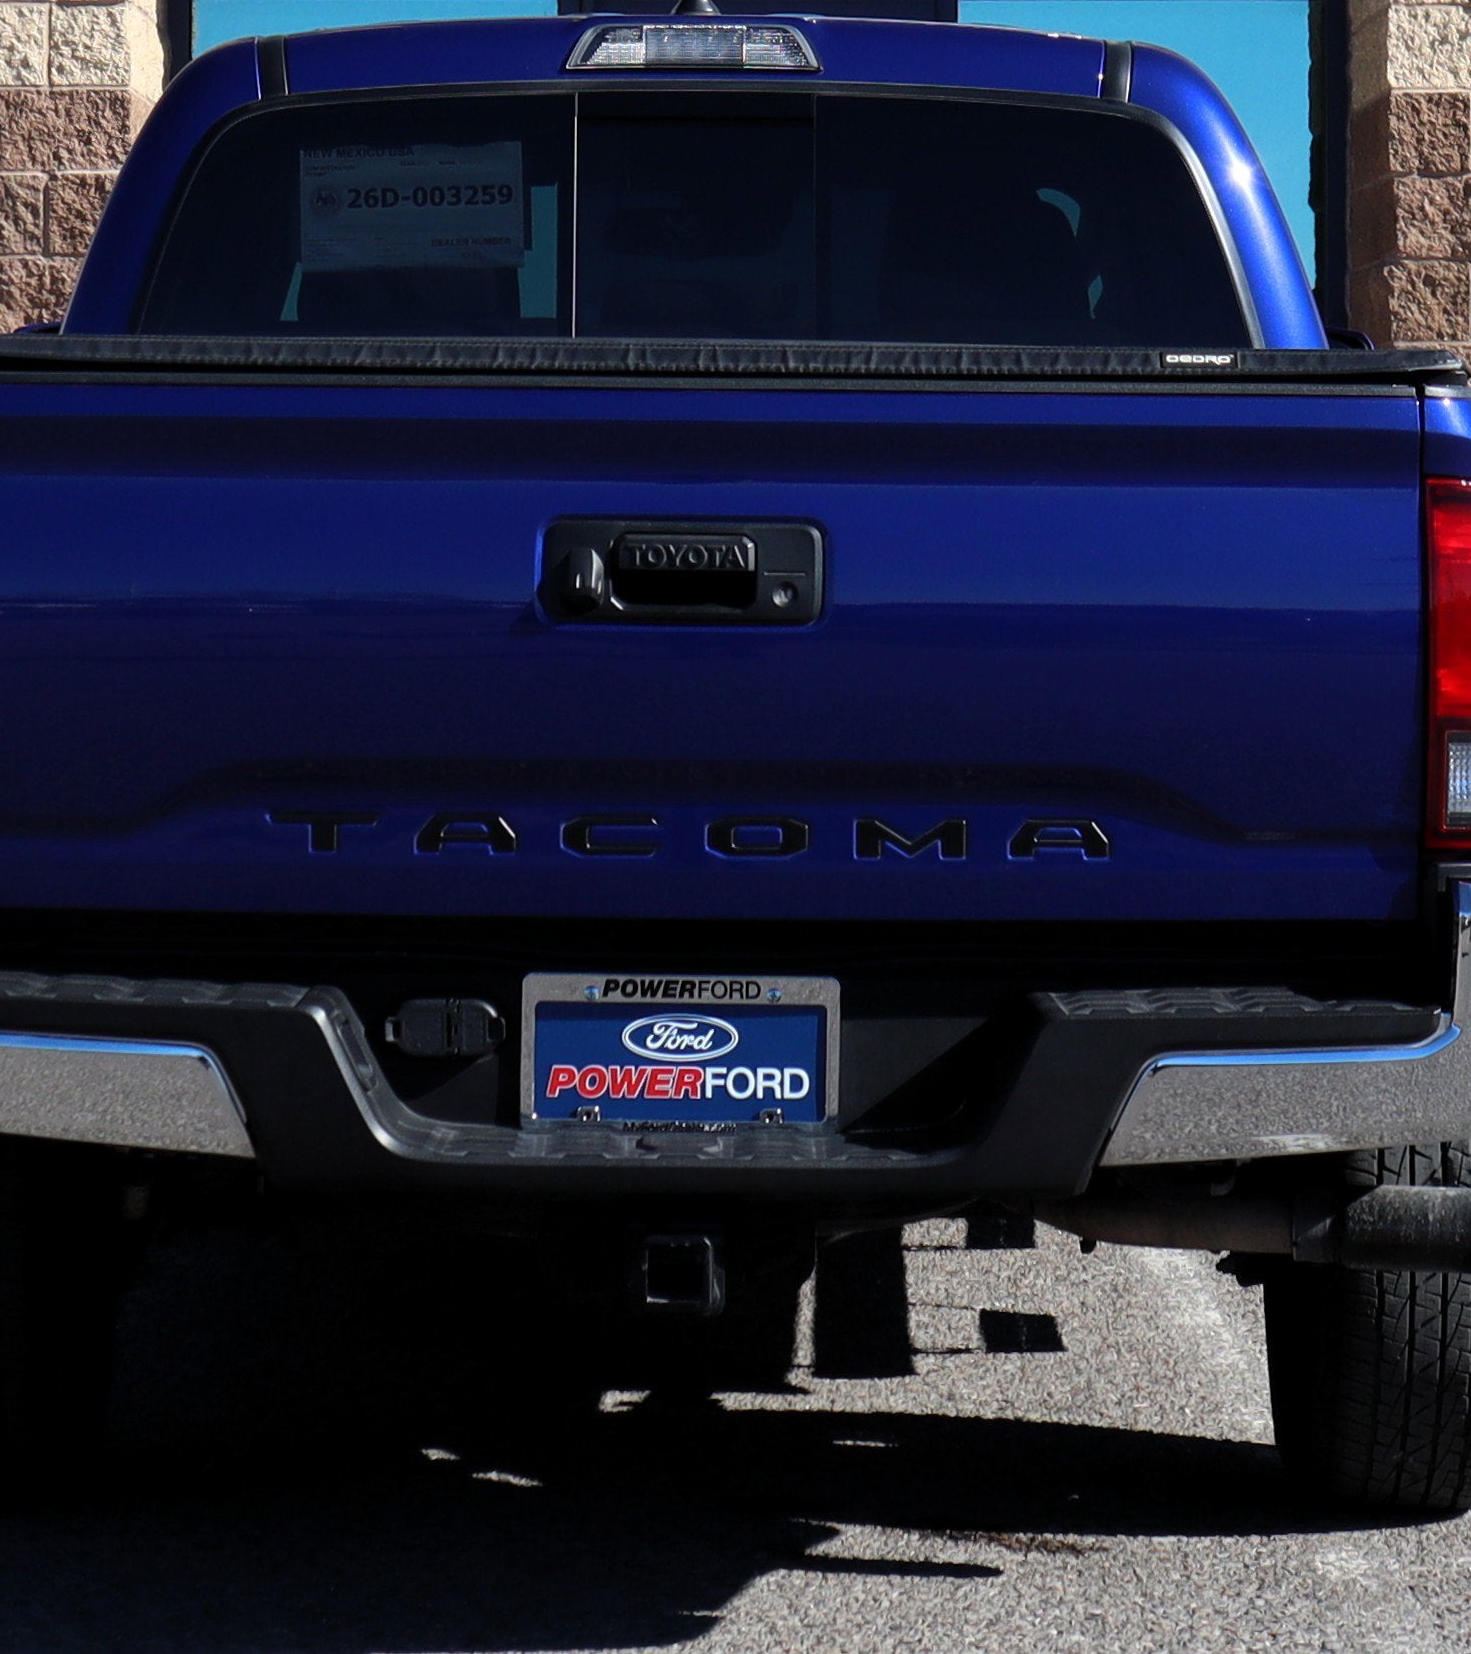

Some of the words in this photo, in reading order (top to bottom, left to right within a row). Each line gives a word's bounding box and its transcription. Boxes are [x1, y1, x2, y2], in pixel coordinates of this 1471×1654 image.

[303, 147, 333, 159] NEW
[336, 146, 385, 159] MEXICO
[388, 145, 415, 157] USA
[346, 183, 514, 209] 26D-003259
[431, 237, 469, 248] DEALER
[471, 236, 511, 246] NUMBER
[627, 543, 746, 569] TOYOTA
[264, 811, 1110, 862] TACOMA
[602, 978, 762, 1001] POWERFORD
[645, 1021, 715, 1051] Ford
[546, 1064, 811, 1100] POWERFORD
